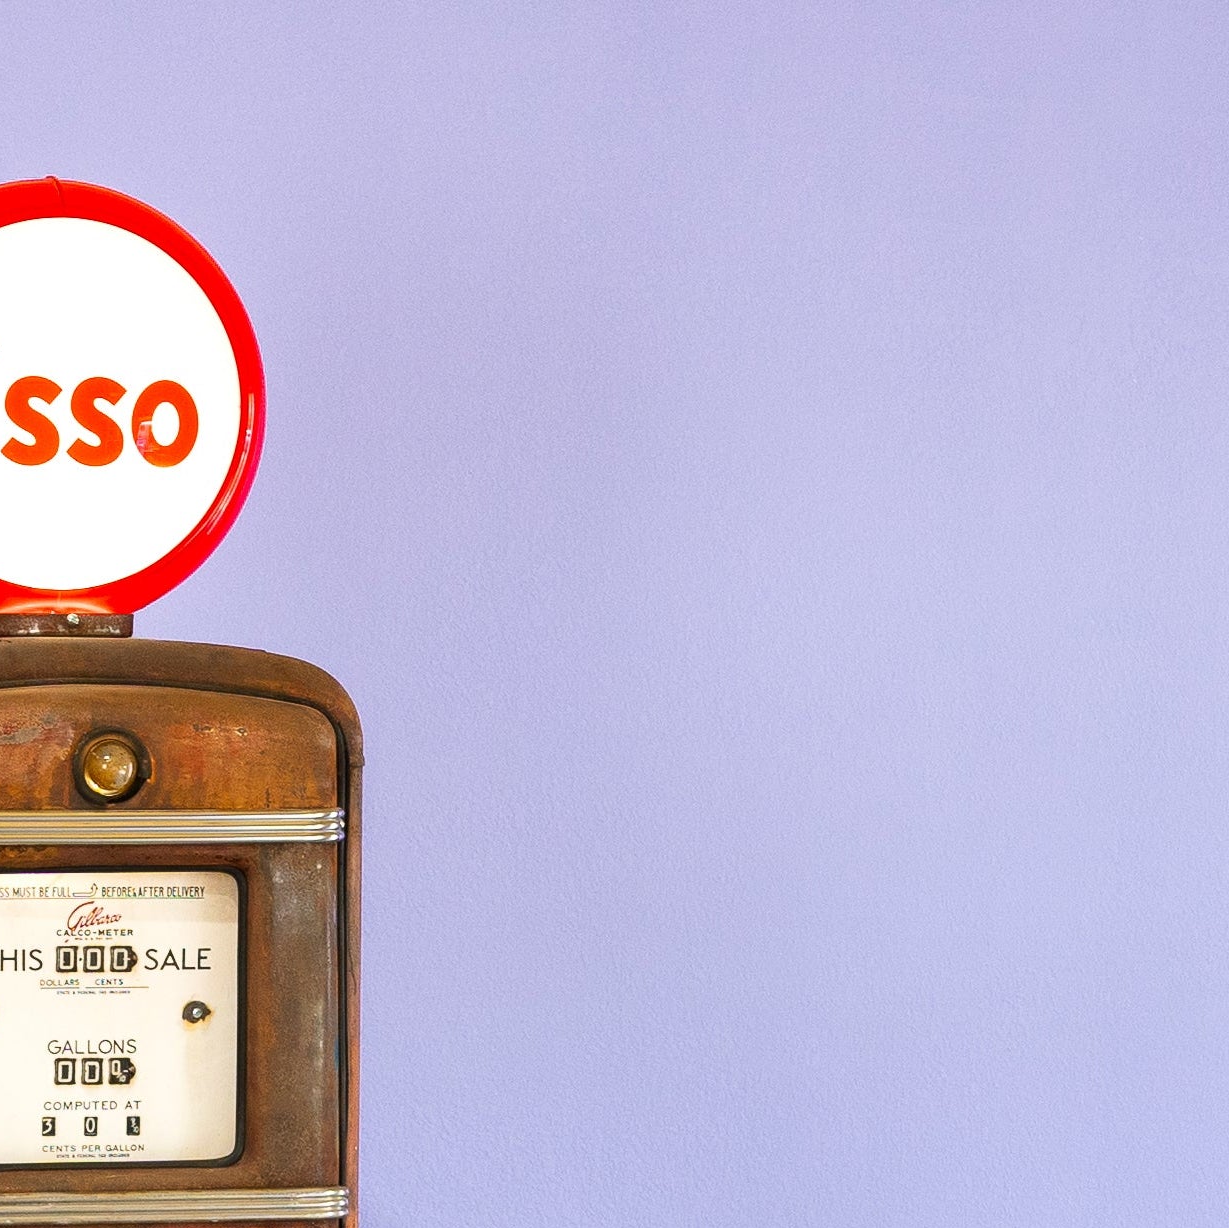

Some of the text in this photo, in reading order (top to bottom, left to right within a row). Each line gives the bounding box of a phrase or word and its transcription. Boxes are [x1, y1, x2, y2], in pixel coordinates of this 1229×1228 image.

[12, 886, 36, 898] MUST
[39, 886, 50, 898] BE
[52, 886, 71, 898] FULL
[101, 886, 132, 897] BEFORE
[138, 886, 164, 897] AFTER
[167, 886, 206, 897] DELIVERY
[56, 928, 134, 937] CALCO-METER
[144, 947, 212, 971] SALE
[39, 978, 124, 987] DOLLARS CENTS
[47, 1038, 137, 1055] GALLONS
[43, 1100, 142, 1111] COMPUTED AT
[42, 1144, 145, 1153] CENTS PER GALLON
